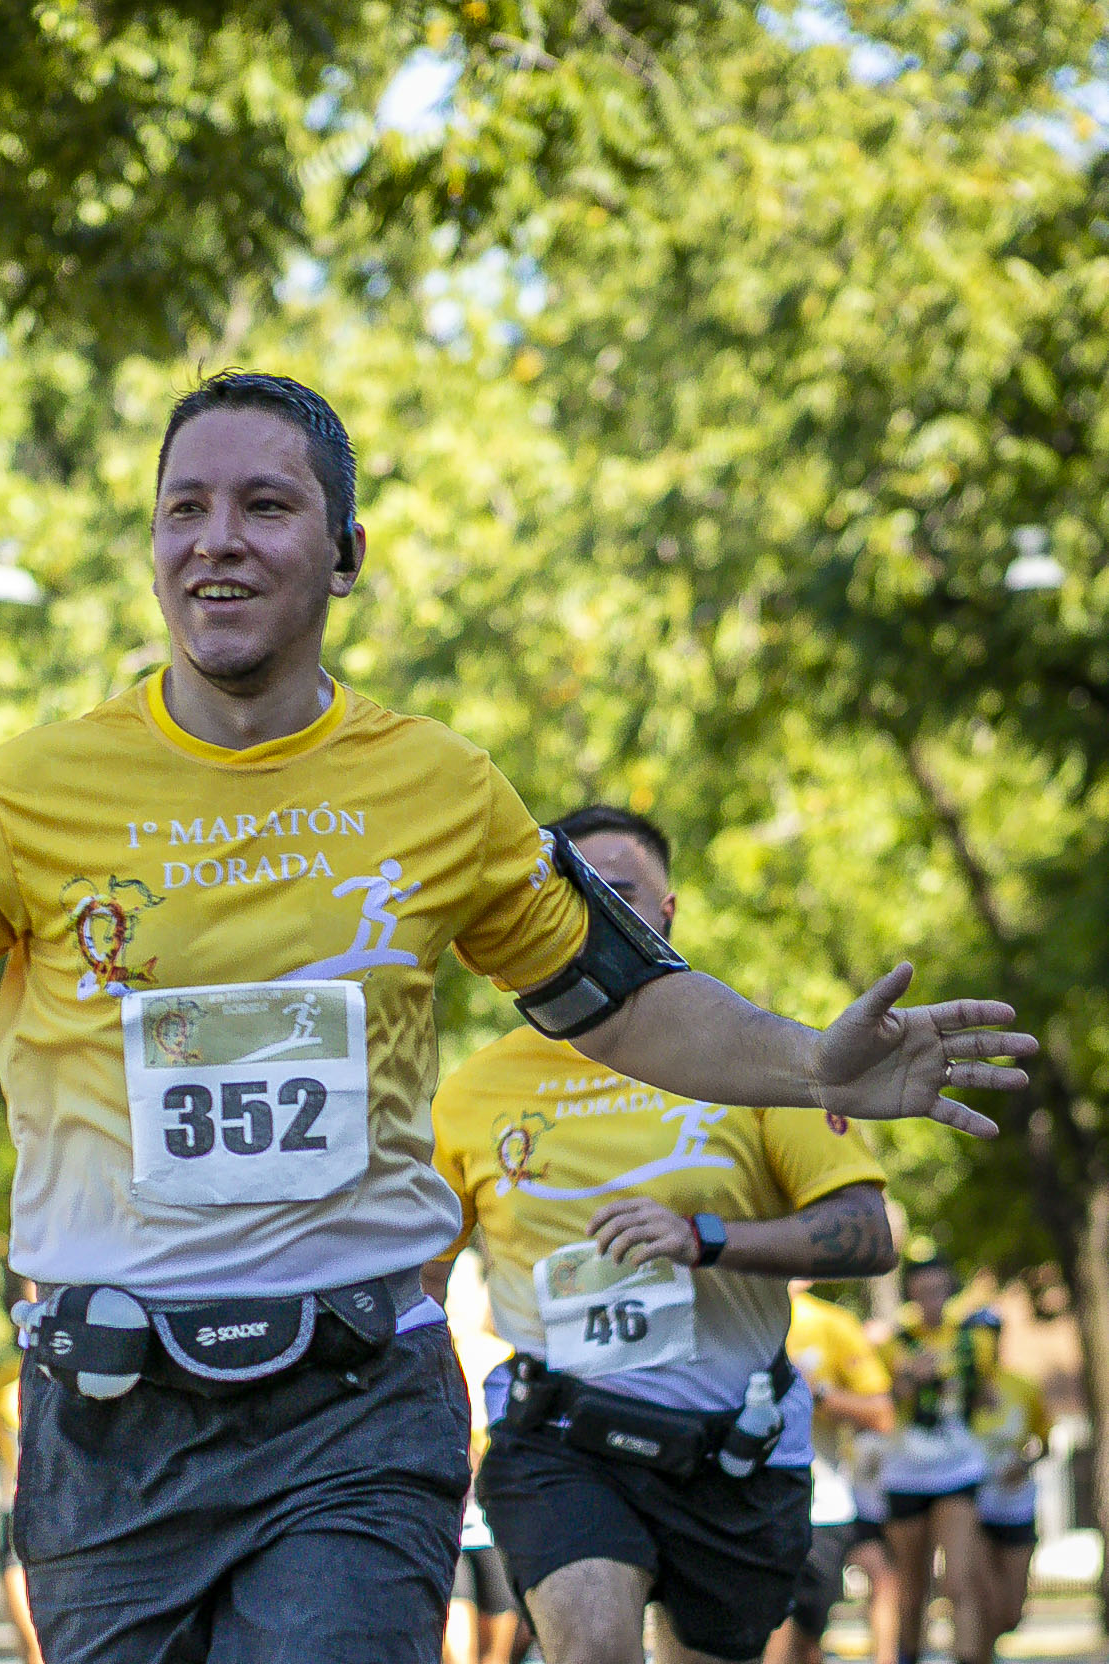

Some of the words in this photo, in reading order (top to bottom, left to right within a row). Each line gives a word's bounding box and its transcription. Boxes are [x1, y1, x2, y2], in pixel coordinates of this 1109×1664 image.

[168, 801, 366, 846] MARATÓN
[162, 851, 335, 889] DORADA
[162, 1077, 328, 1160] 352
[555, 1092, 665, 1119] DORADA
[584, 1300, 648, 1347] 46
